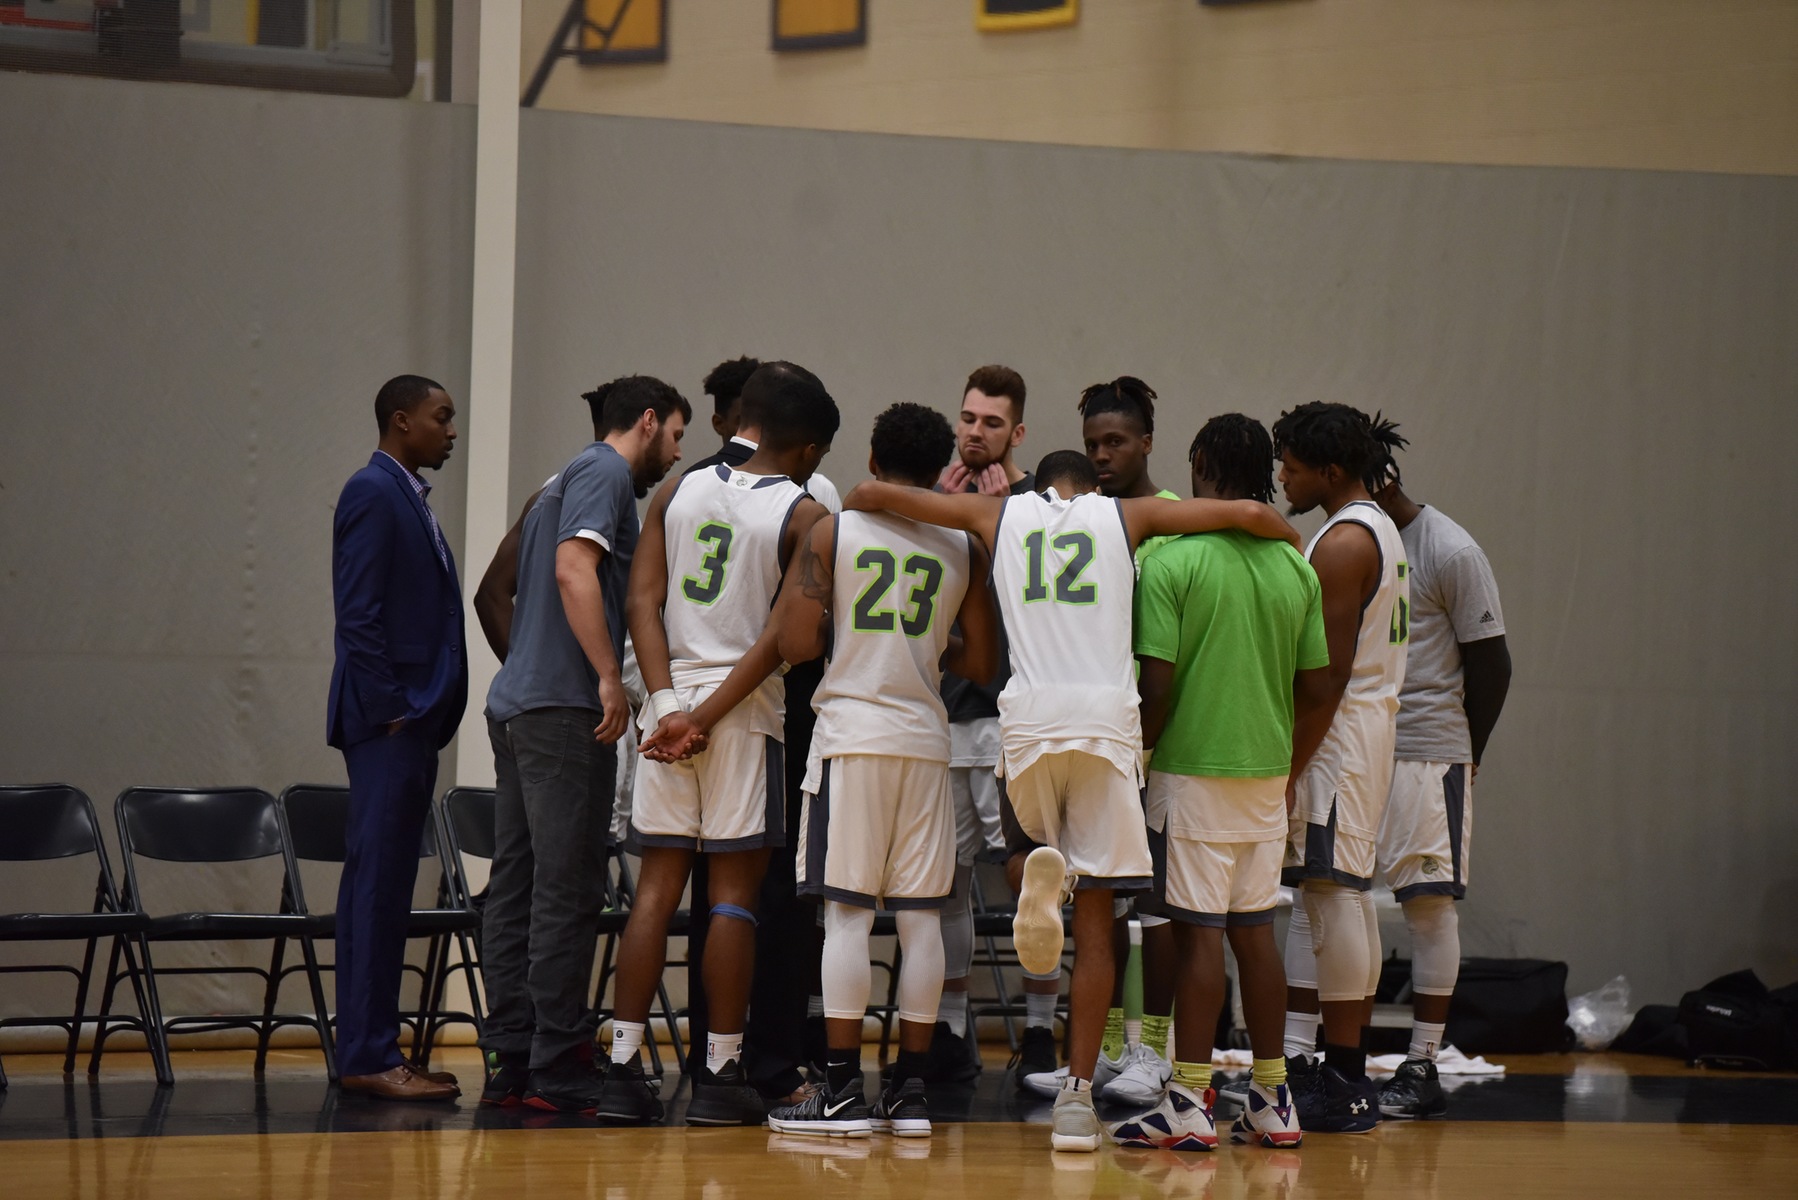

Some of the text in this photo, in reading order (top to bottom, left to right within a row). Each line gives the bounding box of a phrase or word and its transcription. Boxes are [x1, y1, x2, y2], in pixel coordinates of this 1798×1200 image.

[681, 519, 734, 607] 3
[852, 546, 946, 639] 23
[1022, 528, 1098, 605] 12
